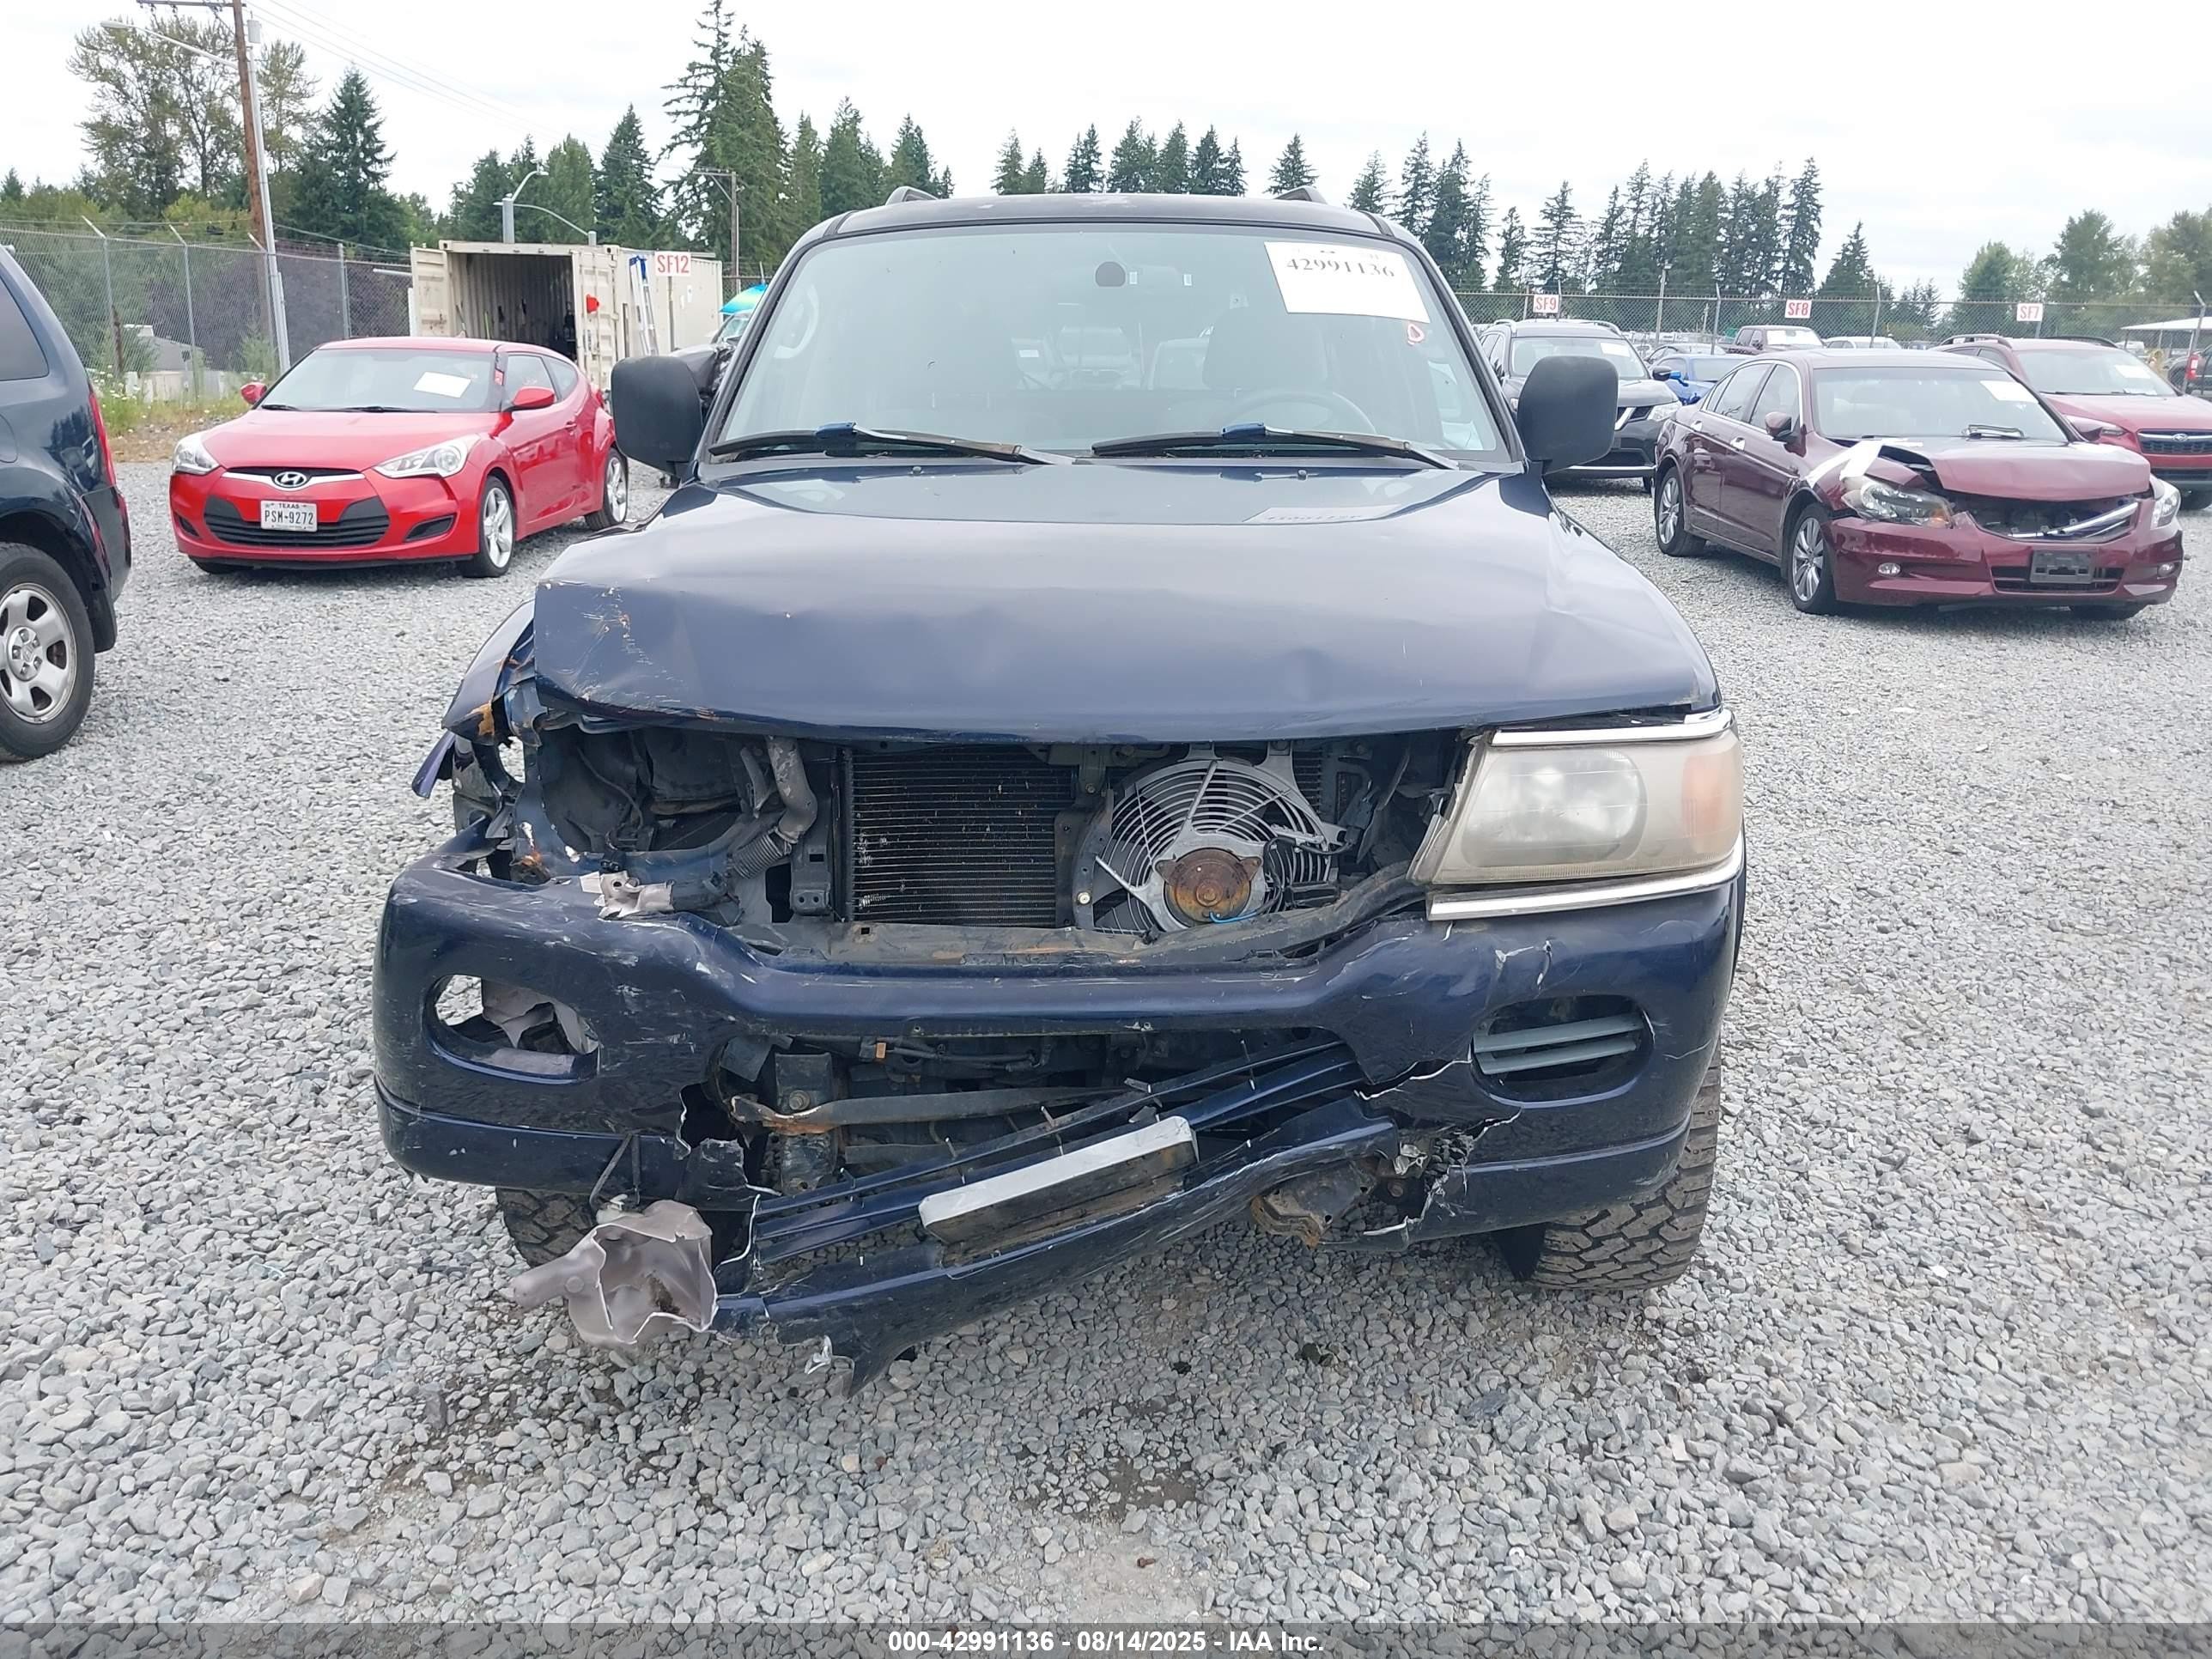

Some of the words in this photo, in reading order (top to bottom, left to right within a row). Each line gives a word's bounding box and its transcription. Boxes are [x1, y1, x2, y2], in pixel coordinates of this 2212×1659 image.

[657, 254, 690, 273] SF12
[1286, 257, 1395, 276] 42991136
[1535, 296, 1557, 310] SF9
[1787, 301, 1808, 316] SF8
[2020, 305, 2040, 319] SF7
